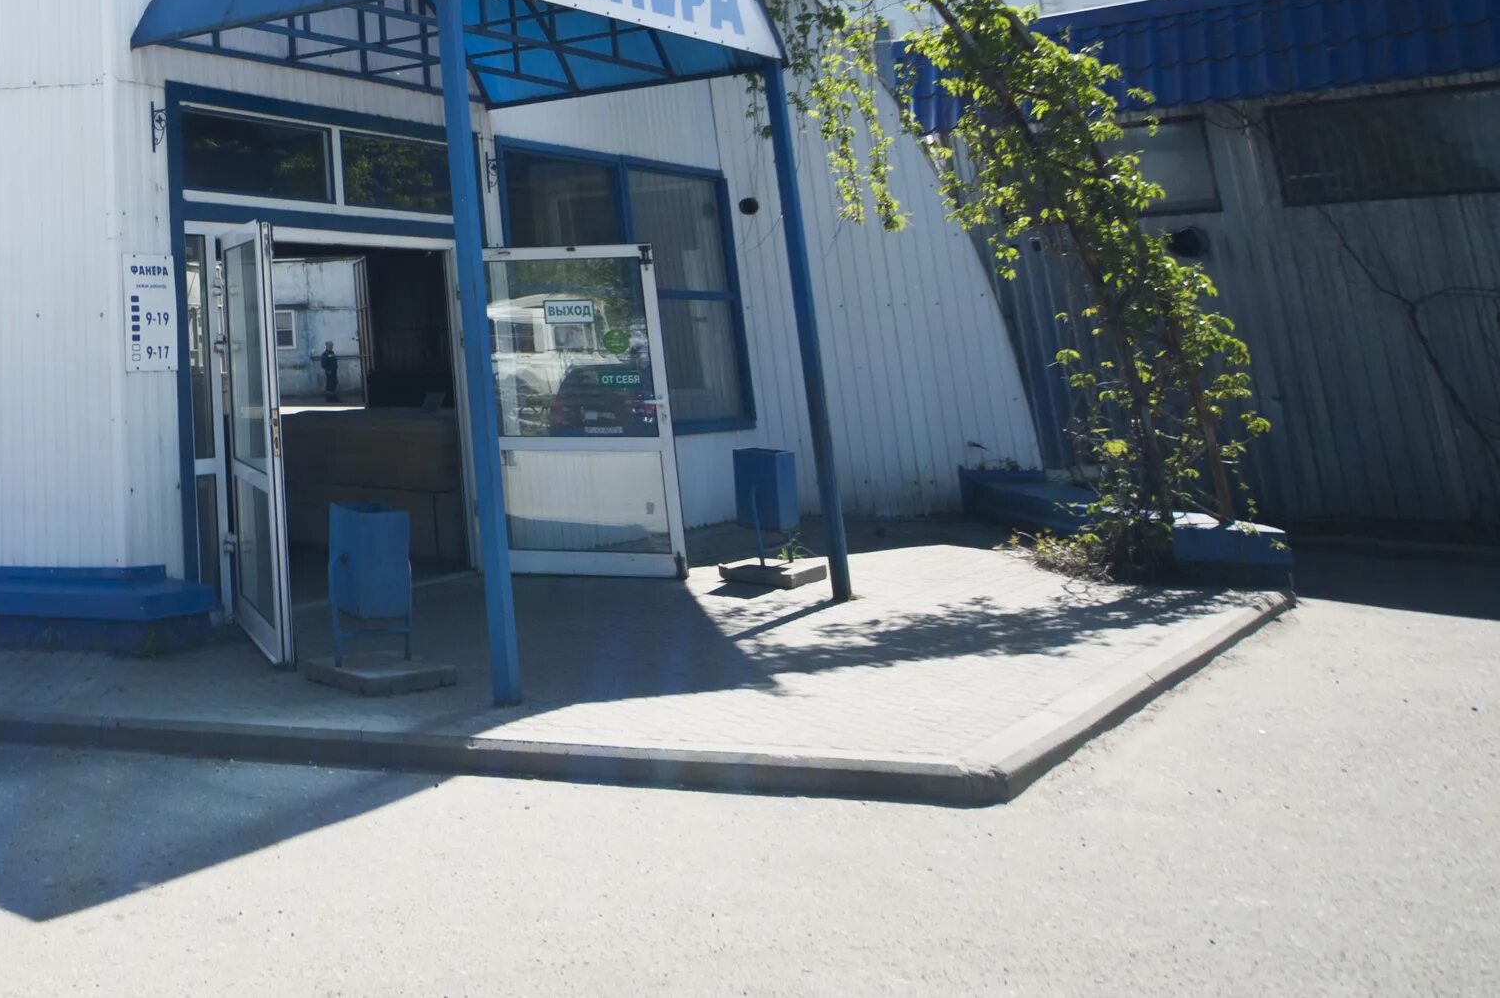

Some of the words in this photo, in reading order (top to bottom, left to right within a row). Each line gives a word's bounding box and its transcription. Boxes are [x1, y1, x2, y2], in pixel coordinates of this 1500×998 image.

[130, 265, 169, 276] ФАНЕРА
[547, 305, 592, 317] ВЫХОД
[145, 312, 170, 325] 9-19
[146, 346, 170, 359] 9-17
[601, 375, 615, 384] ОТ
[615, 375, 641, 384] СЕБЯ
